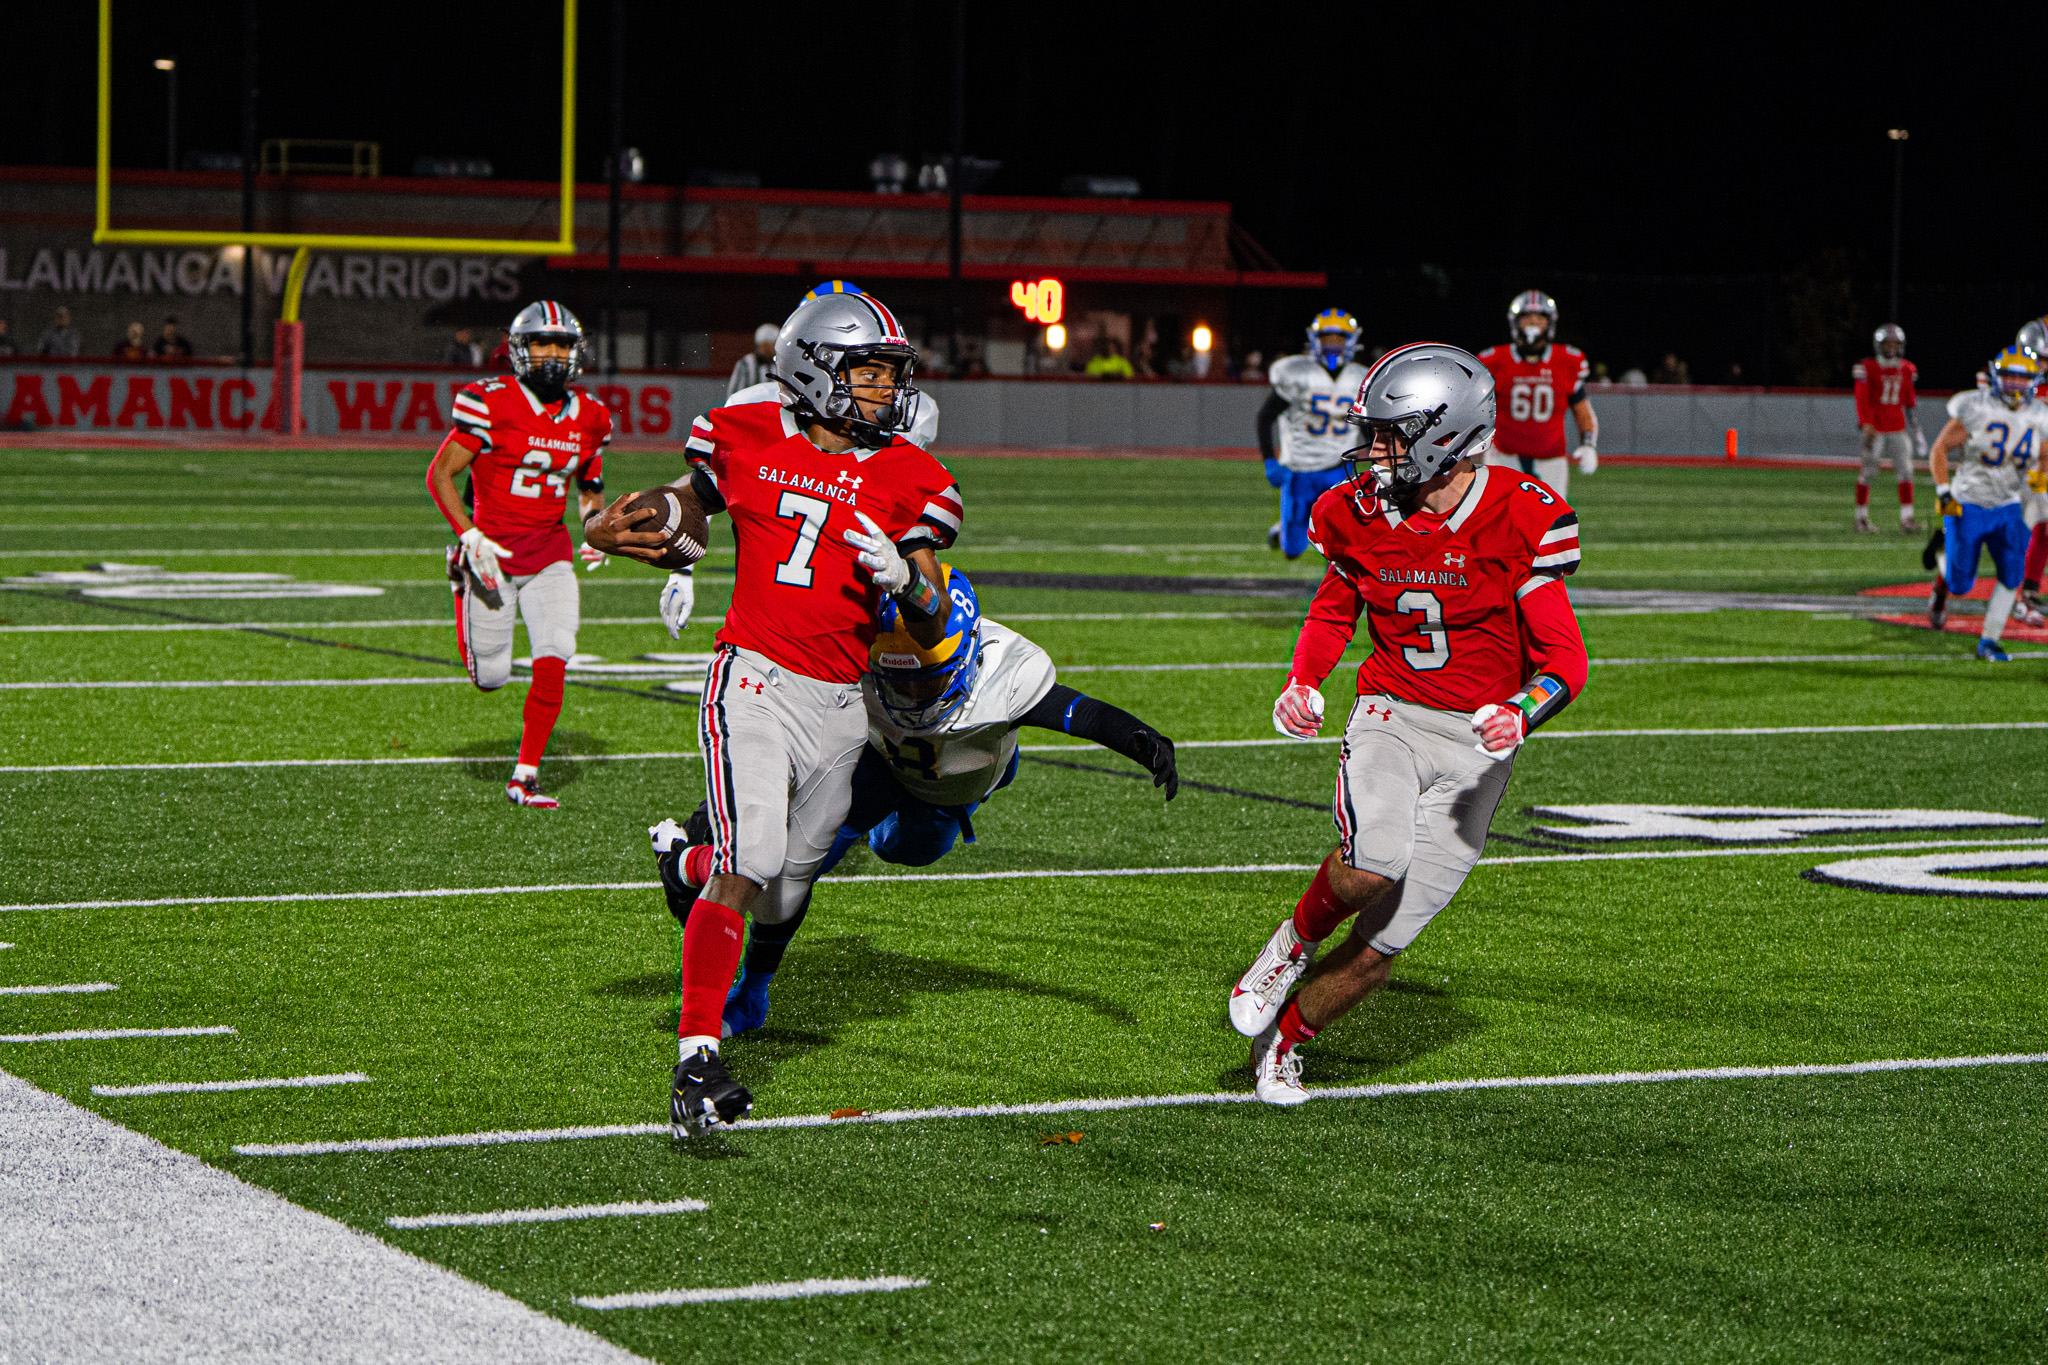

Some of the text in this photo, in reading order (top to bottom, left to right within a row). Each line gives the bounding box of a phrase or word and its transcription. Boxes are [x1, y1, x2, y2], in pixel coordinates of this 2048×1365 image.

[1010, 278, 1063, 323] 40
[1510, 384, 1555, 423] 60
[1880, 379, 1902, 406] 11
[528, 435, 580, 452] SALAMANCA
[1980, 421, 2034, 469] 34
[509, 448, 580, 498] 24
[758, 466, 857, 506] SALAMANCA
[1518, 480, 1556, 505] 3
[774, 489, 832, 588] 7
[1379, 567, 1468, 586] SALAMANCA
[950, 588, 976, 619] 8
[1396, 588, 1451, 671] 3
[882, 656, 915, 666] Riddell
